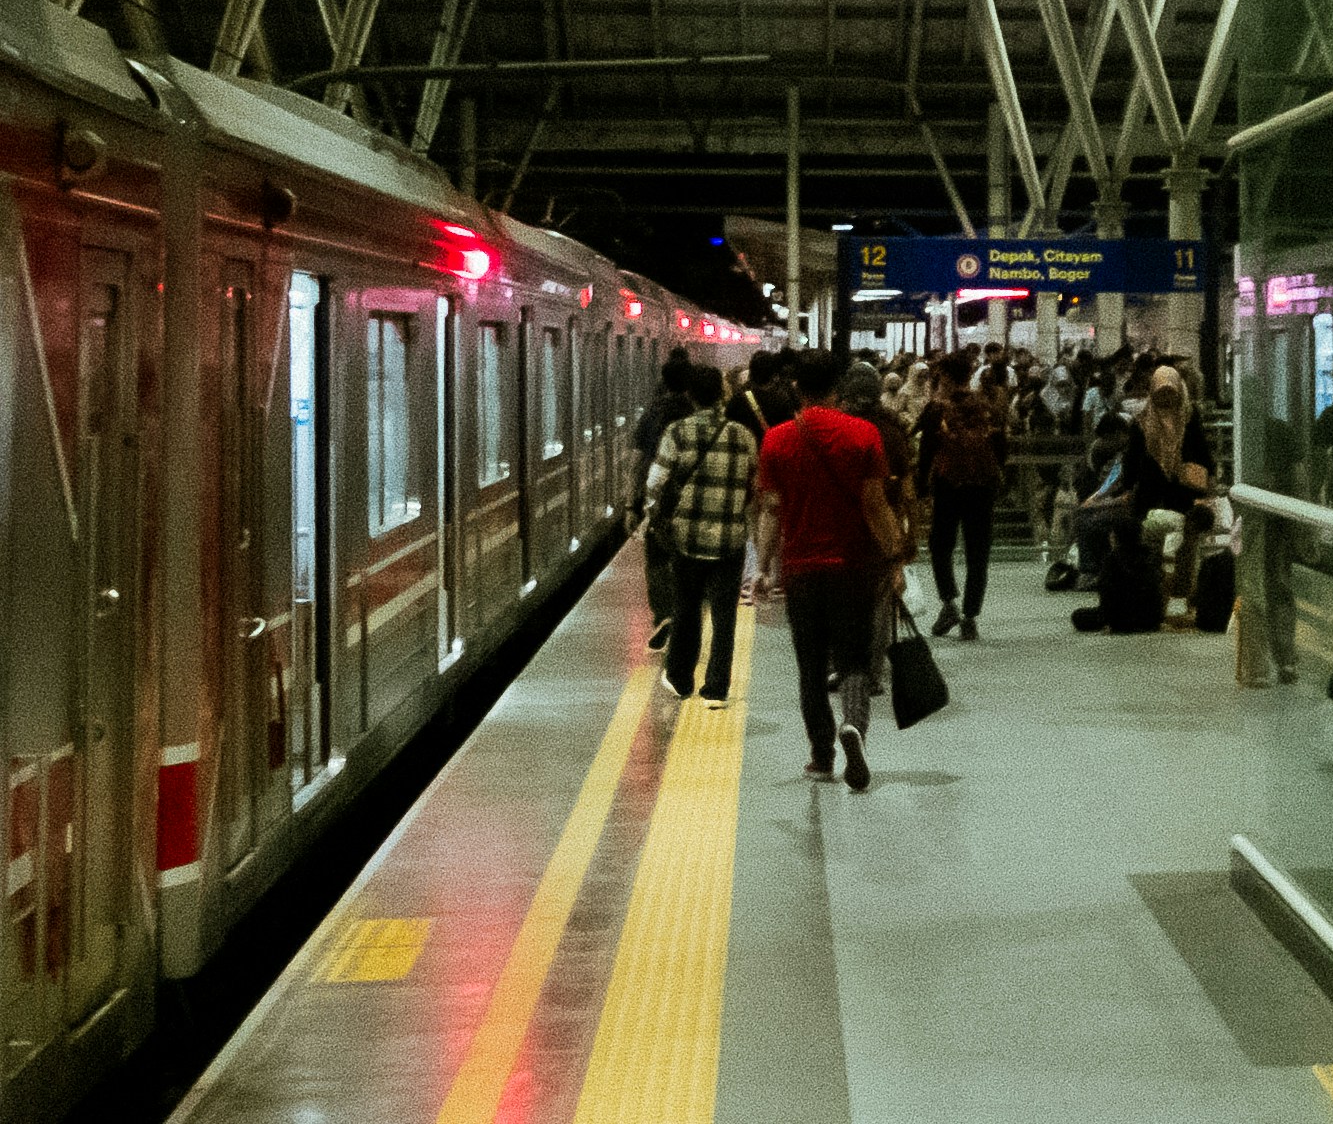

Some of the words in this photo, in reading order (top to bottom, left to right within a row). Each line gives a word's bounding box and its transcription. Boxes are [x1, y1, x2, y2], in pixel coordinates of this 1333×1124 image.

[859, 245, 887, 266] 12
[1043, 249, 1104, 265] Citayam
[1173, 248, 1195, 269] 11
[1048, 266, 1091, 283] Bogor
